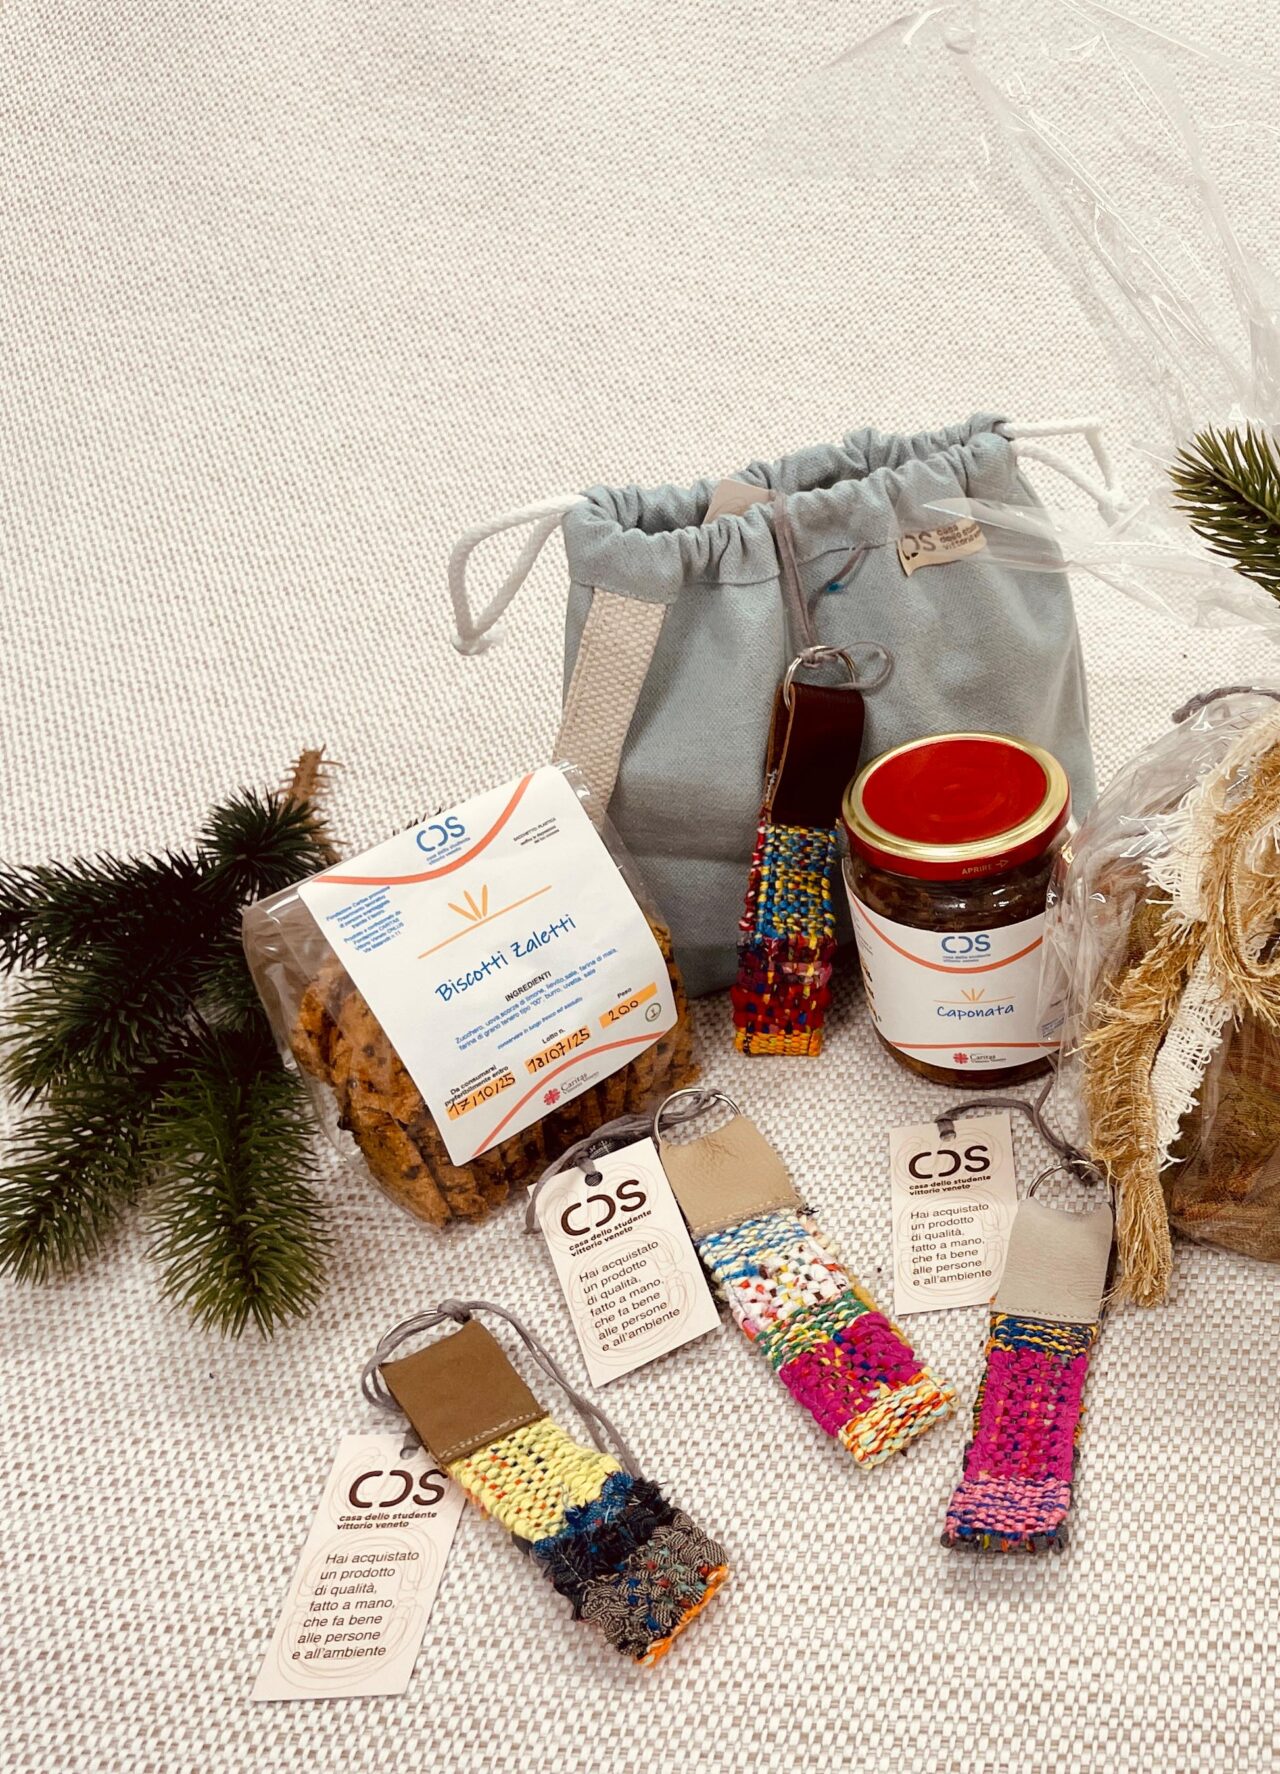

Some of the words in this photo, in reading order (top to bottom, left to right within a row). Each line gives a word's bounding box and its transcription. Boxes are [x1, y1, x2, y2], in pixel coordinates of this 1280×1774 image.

[961, 864, 992, 875] APRIRE
[434, 950, 509, 1002] Biscotti
[510, 913, 576, 958] Zaletti
[504, 970, 552, 1002] INGREDIENTI
[608, 1000, 639, 1022] 200
[937, 1004, 1014, 1020] Caponata
[541, 1031, 559, 1044] Lotto
[449, 1087, 460, 1095] Da
[449, 1073, 516, 1116] 17/10/25
[929, 1179, 952, 1187] dello
[953, 1175, 991, 1185] studente
[908, 1187, 940, 1196] vittorio
[941, 1183, 971, 1192] veneto
[910, 1211, 929, 1220] Hai
[932, 1203, 989, 1217] acquistato
[568, 1238, 589, 1251] casa
[590, 1228, 613, 1241] dello
[613, 1209, 652, 1231] studente
[910, 1223, 925, 1231] un
[928, 1216, 974, 1230] prodotto
[570, 1239, 603, 1257] vittorio
[603, 1225, 633, 1242] veneto
[910, 1233, 921, 1242] di
[911, 1243, 937, 1253] fatto
[578, 1267, 599, 1283] Hai
[601, 1241, 659, 1272] acquistato
[911, 1254, 933, 1264] che
[935, 1252, 947, 1260] fa
[949, 1249, 978, 1259] bene
[912, 1265, 933, 1275] alle
[935, 1259, 982, 1274] persone
[583, 1282, 598, 1294] un
[600, 1259, 647, 1288] prodotto
[586, 1294, 598, 1306] di
[589, 1300, 616, 1317] fatto
[618, 1295, 627, 1304] a
[594, 1314, 615, 1329] che
[617, 1307, 630, 1317] fa
[631, 1292, 660, 1310] bene
[598, 1325, 618, 1340] alle
[621, 1301, 667, 1331] persone
[601, 1343, 610, 1352] e
[363, 1512, 390, 1521] dello
[391, 1511, 437, 1520] studente
[336, 1521, 373, 1530] vittorio
[375, 1520, 410, 1529] veneto
[325, 1553, 349, 1564] Hai
[351, 1551, 420, 1565] acquistato
[319, 1570, 337, 1580] un
[339, 1567, 396, 1582] prodotto
[313, 1584, 327, 1596] di
[309, 1600, 339, 1612] fatto
[341, 1601, 351, 1610] a
[302, 1616, 328, 1628] che
[331, 1615, 345, 1626] fa
[348, 1614, 383, 1626] bene
[297, 1632, 322, 1644] alle
[323, 1631, 381, 1645] persone
[291, 1651, 301, 1660] e
